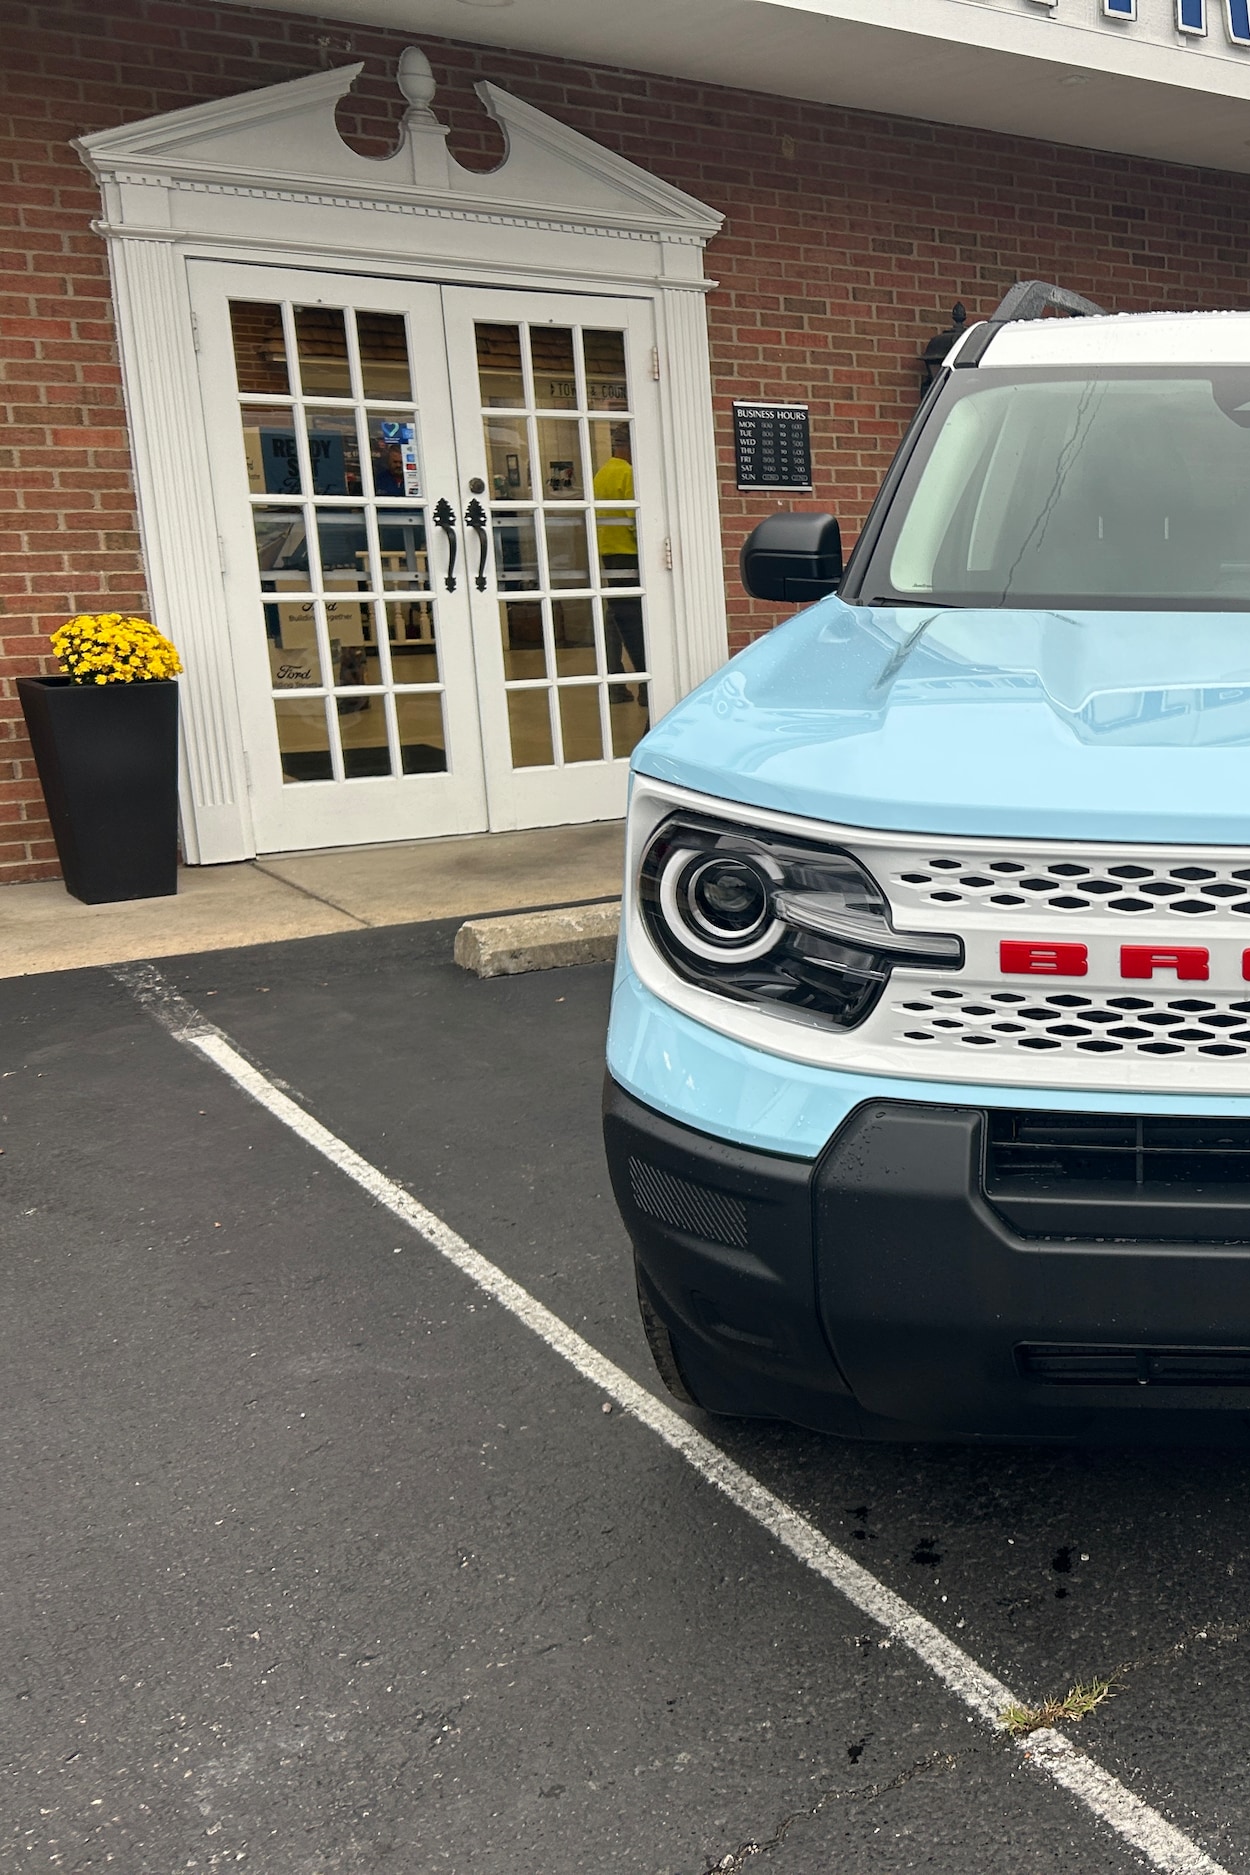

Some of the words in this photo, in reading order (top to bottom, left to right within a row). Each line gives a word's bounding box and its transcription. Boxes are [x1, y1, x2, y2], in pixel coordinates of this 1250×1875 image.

[737, 409, 775, 419] BUSINESS
[777, 411, 806, 420] HOURS
[271, 437, 332, 459] REDY
[276, 664, 312, 680] Ford
